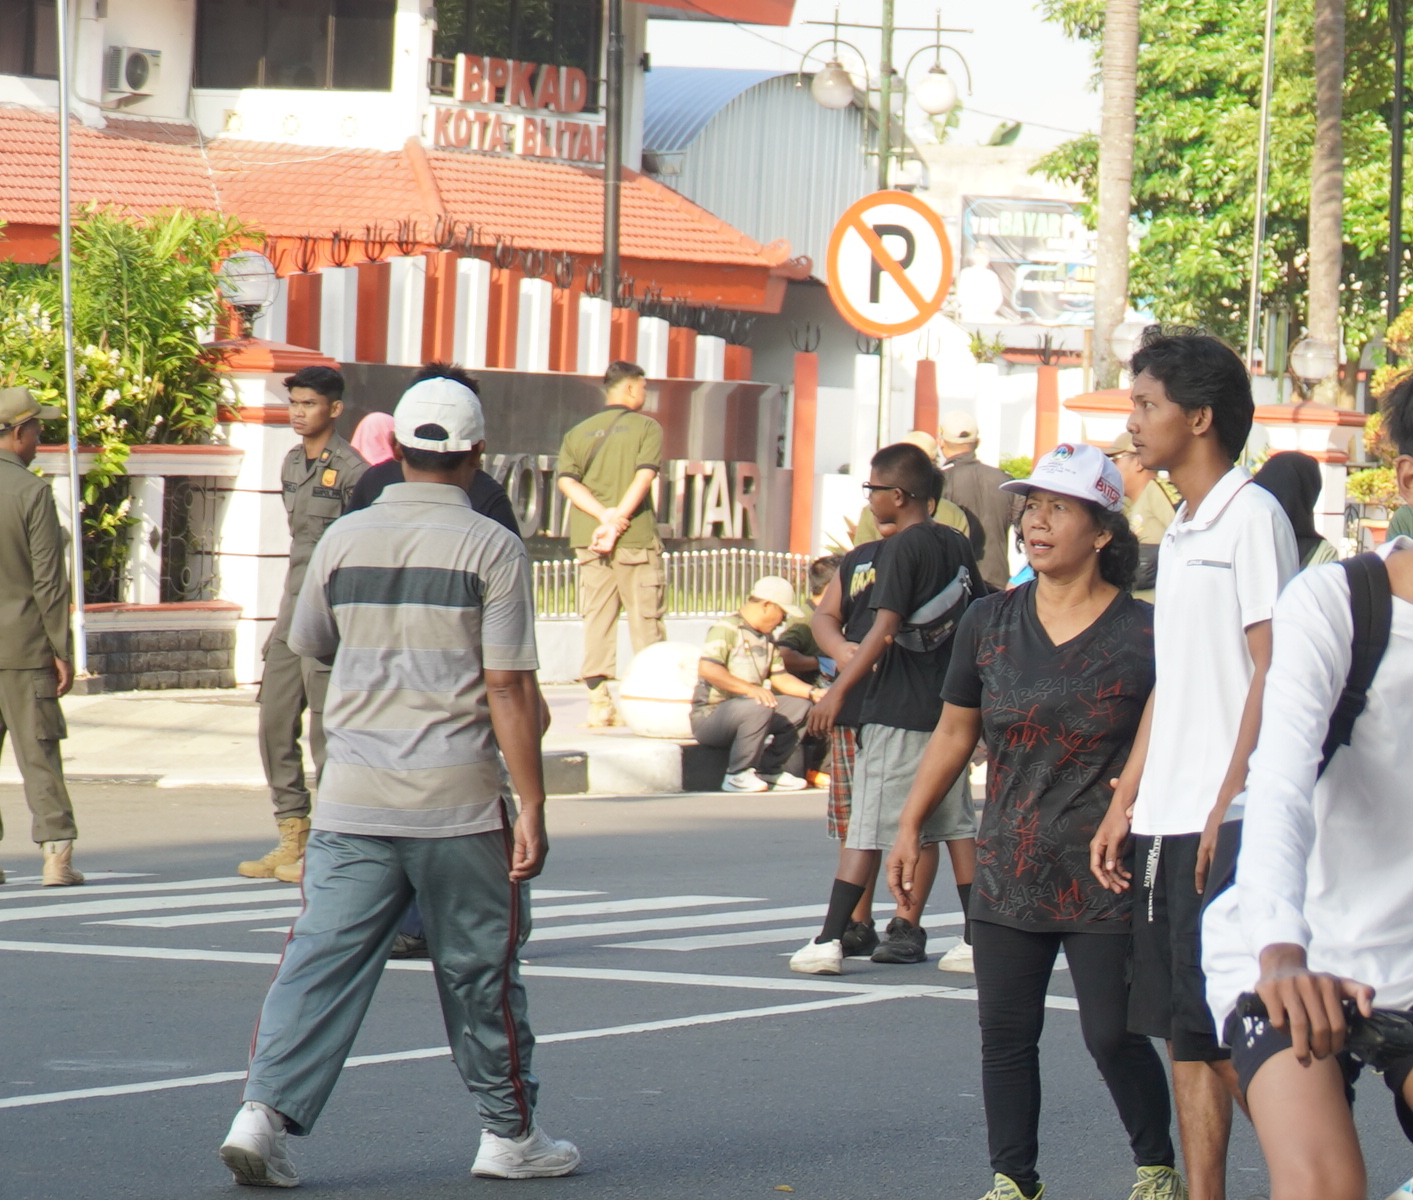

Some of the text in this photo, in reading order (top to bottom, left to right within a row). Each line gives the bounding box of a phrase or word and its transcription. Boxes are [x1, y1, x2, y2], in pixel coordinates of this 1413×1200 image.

[457, 53, 587, 113] BPKAD
[431, 106, 505, 152] KOTA
[652, 459, 762, 539] LITAR
[851, 568, 876, 599] RAJA
[1034, 676, 1098, 697] ZARA
[1008, 881, 1058, 907] ZARA
